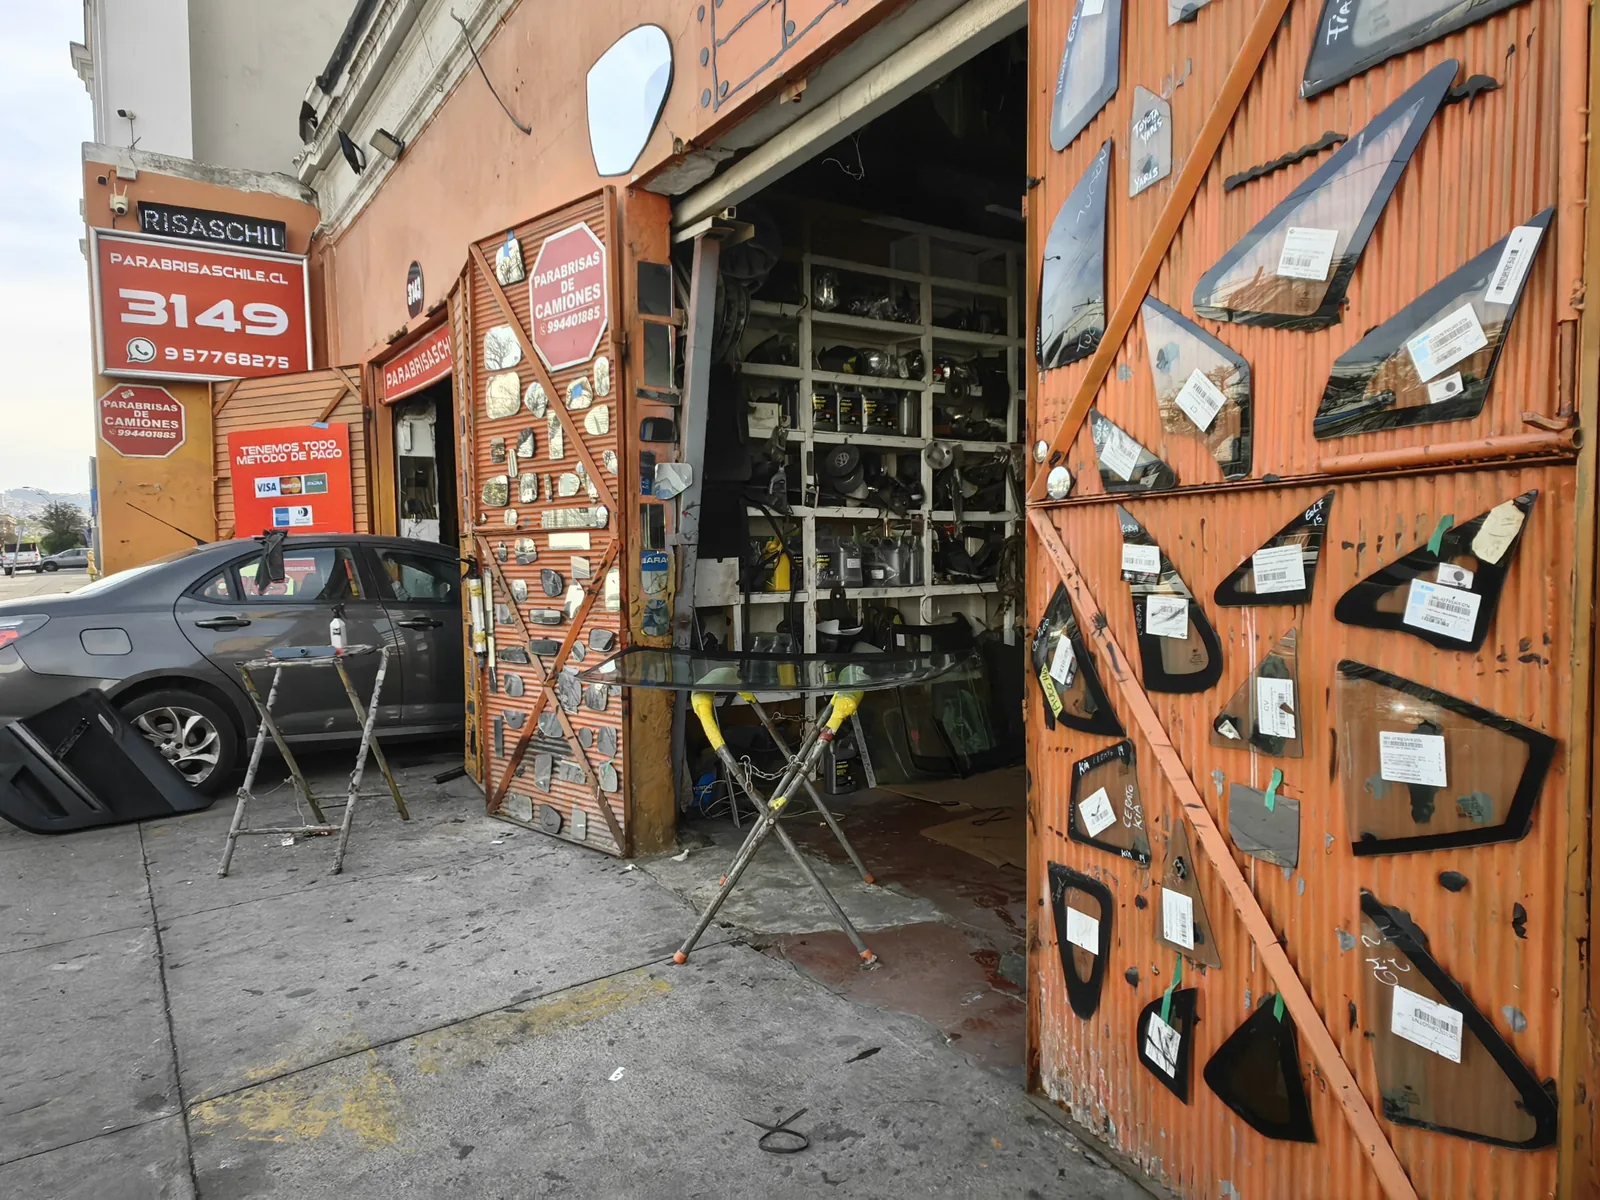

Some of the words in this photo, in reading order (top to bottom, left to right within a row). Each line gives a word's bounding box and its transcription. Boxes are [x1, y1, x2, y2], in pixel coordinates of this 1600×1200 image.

[1133, 166, 1159, 193] YARIS
[109, 252, 289, 285] PARABRISASCHILE.CL
[534, 250, 600, 289] PARABRISAS
[560, 277, 575, 294] DE
[118, 287, 289, 336] 3149
[535, 282, 601, 319] CAMIONES
[546, 305, 600, 334] 994401885
[103, 400, 179, 412] PARABRISAS
[133, 409, 150, 418] DE
[104, 416, 180, 429] CAMIONES
[117, 429, 177, 439] 994401885
[236, 453, 287, 466] METODO
[290, 452, 307, 462] DE
[310, 448, 343, 460] PAGO
[240, 442, 300, 456] TENEMOS
[302, 439, 337, 451] TODO
[256, 482, 278, 493] VISA
[1123, 784, 1134, 829] CERATO
[1133, 804, 1144, 831] KIA
